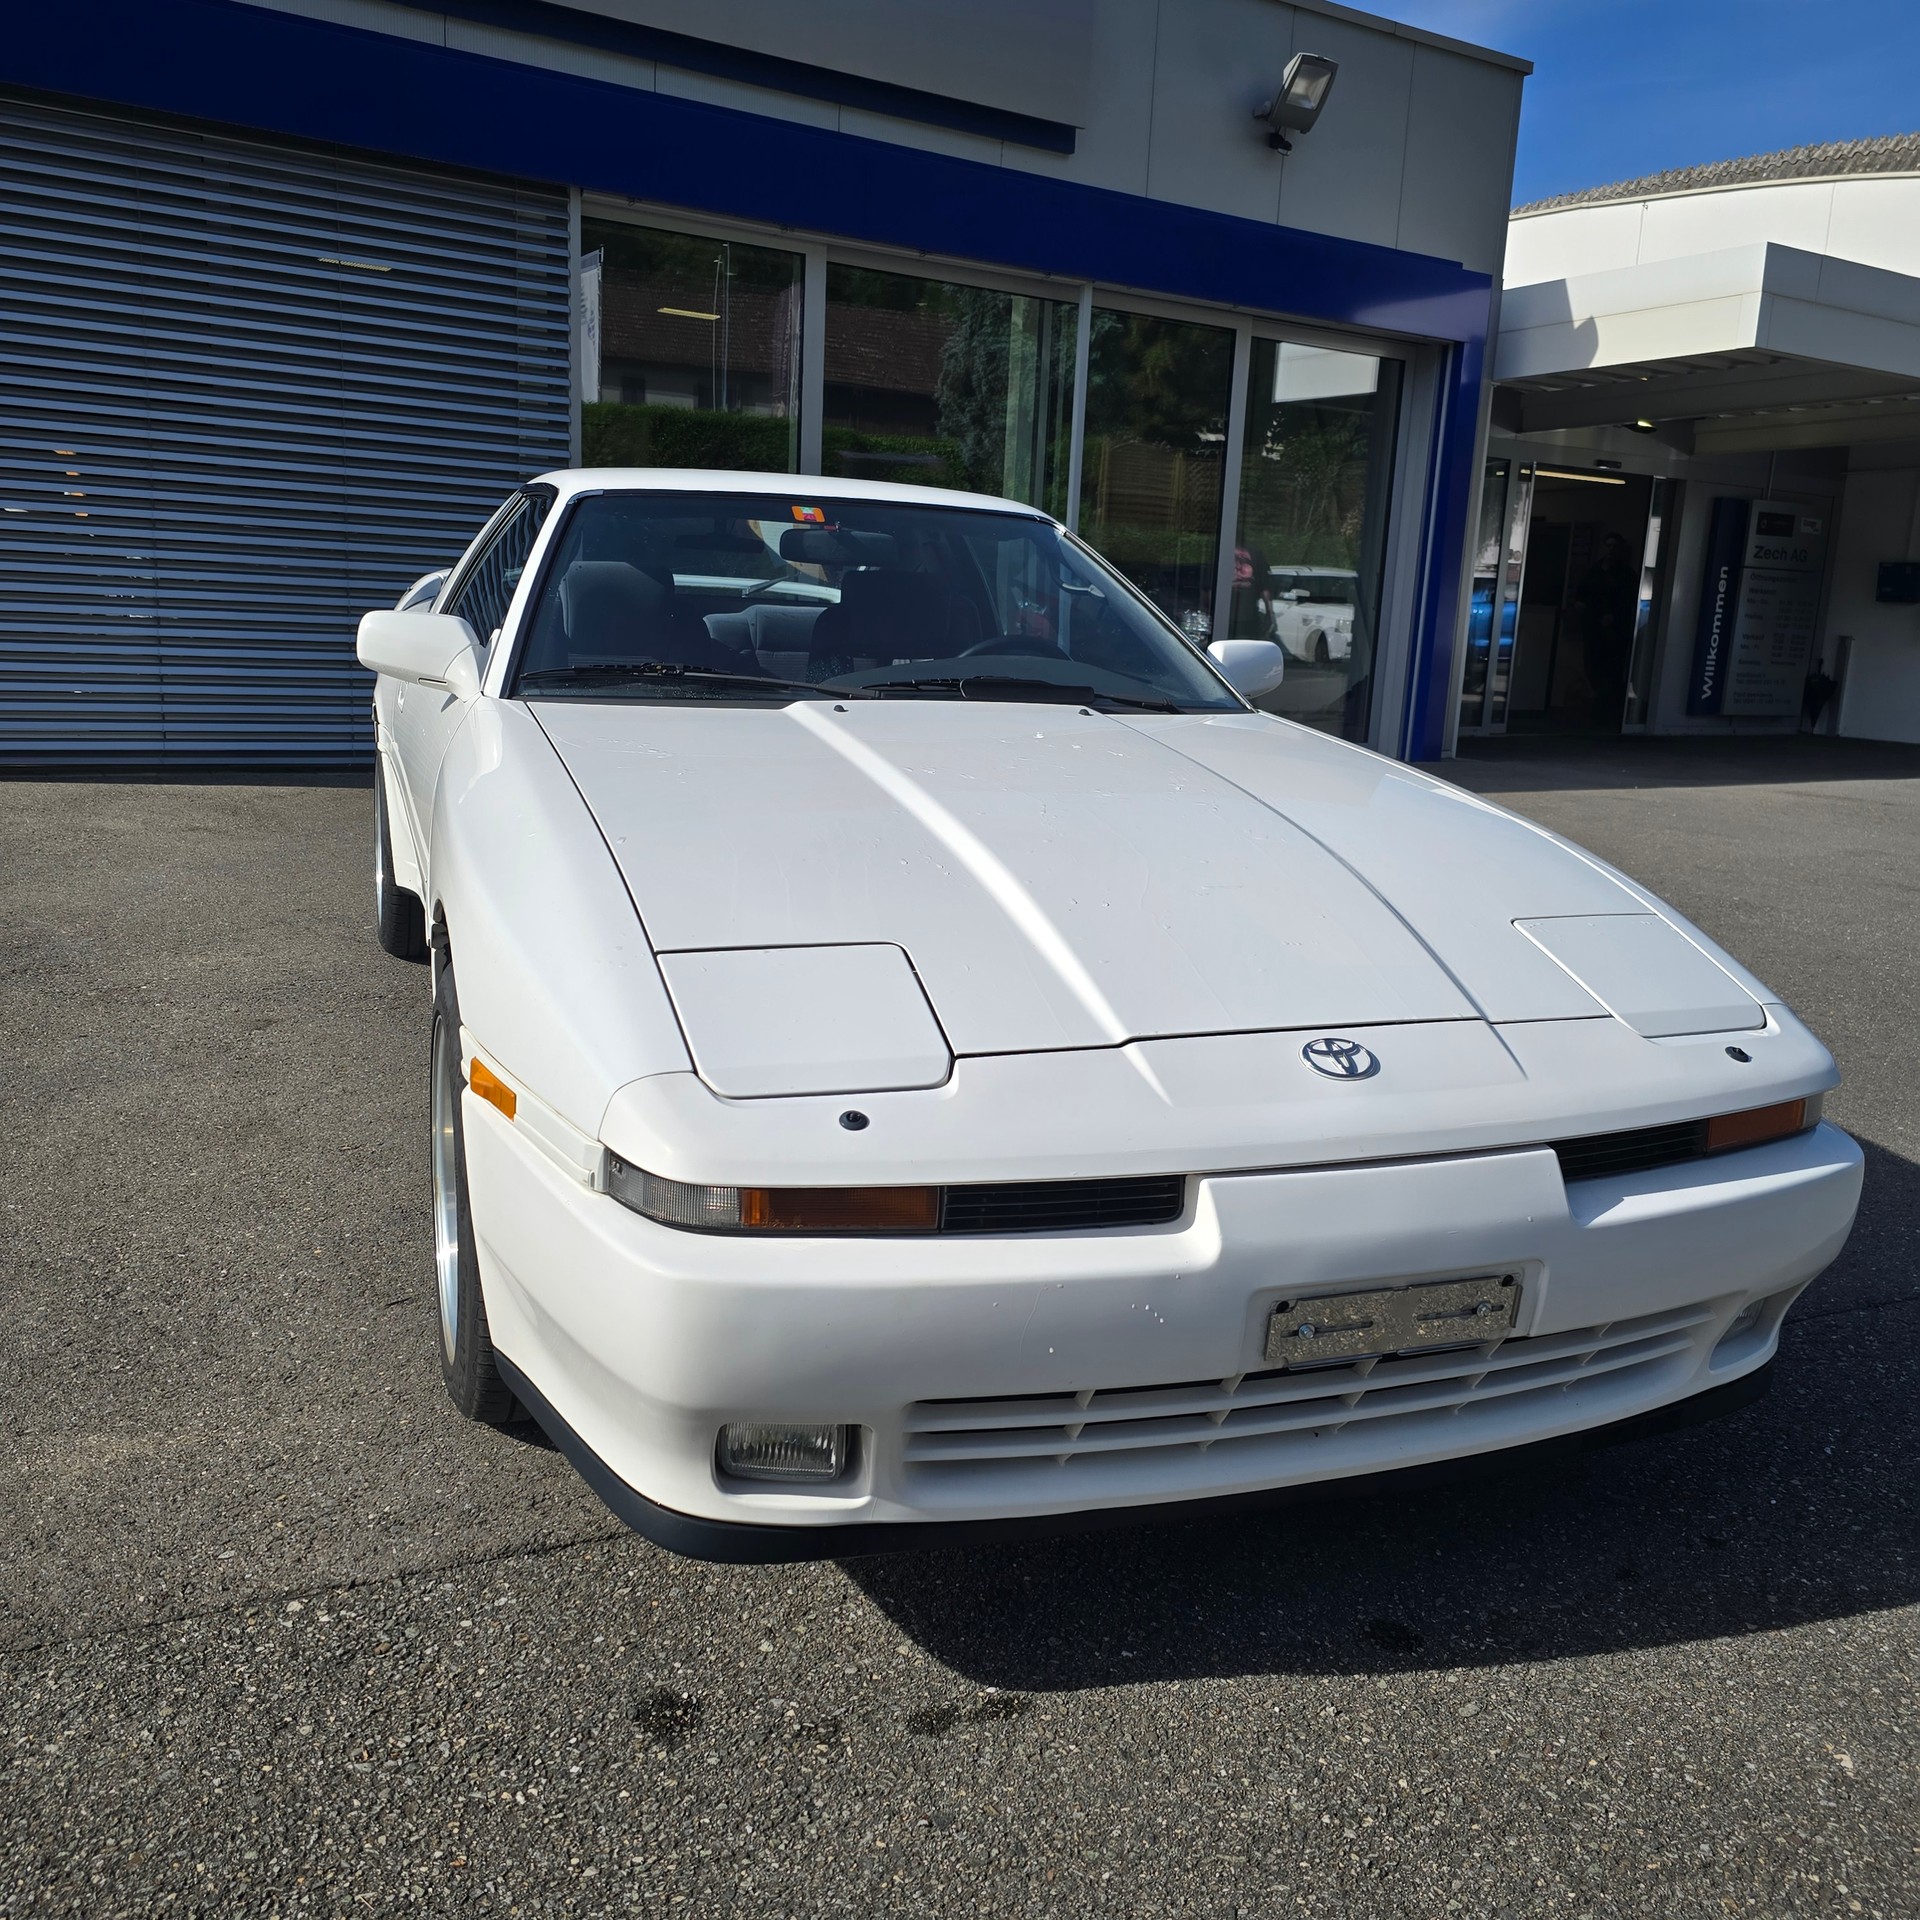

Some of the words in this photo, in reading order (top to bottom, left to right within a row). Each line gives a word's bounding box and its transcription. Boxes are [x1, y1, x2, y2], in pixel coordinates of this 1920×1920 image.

[1753, 545, 1788, 561] Zech
[1790, 548, 1808, 562] AG
[1701, 566, 1729, 699] Willkommen
